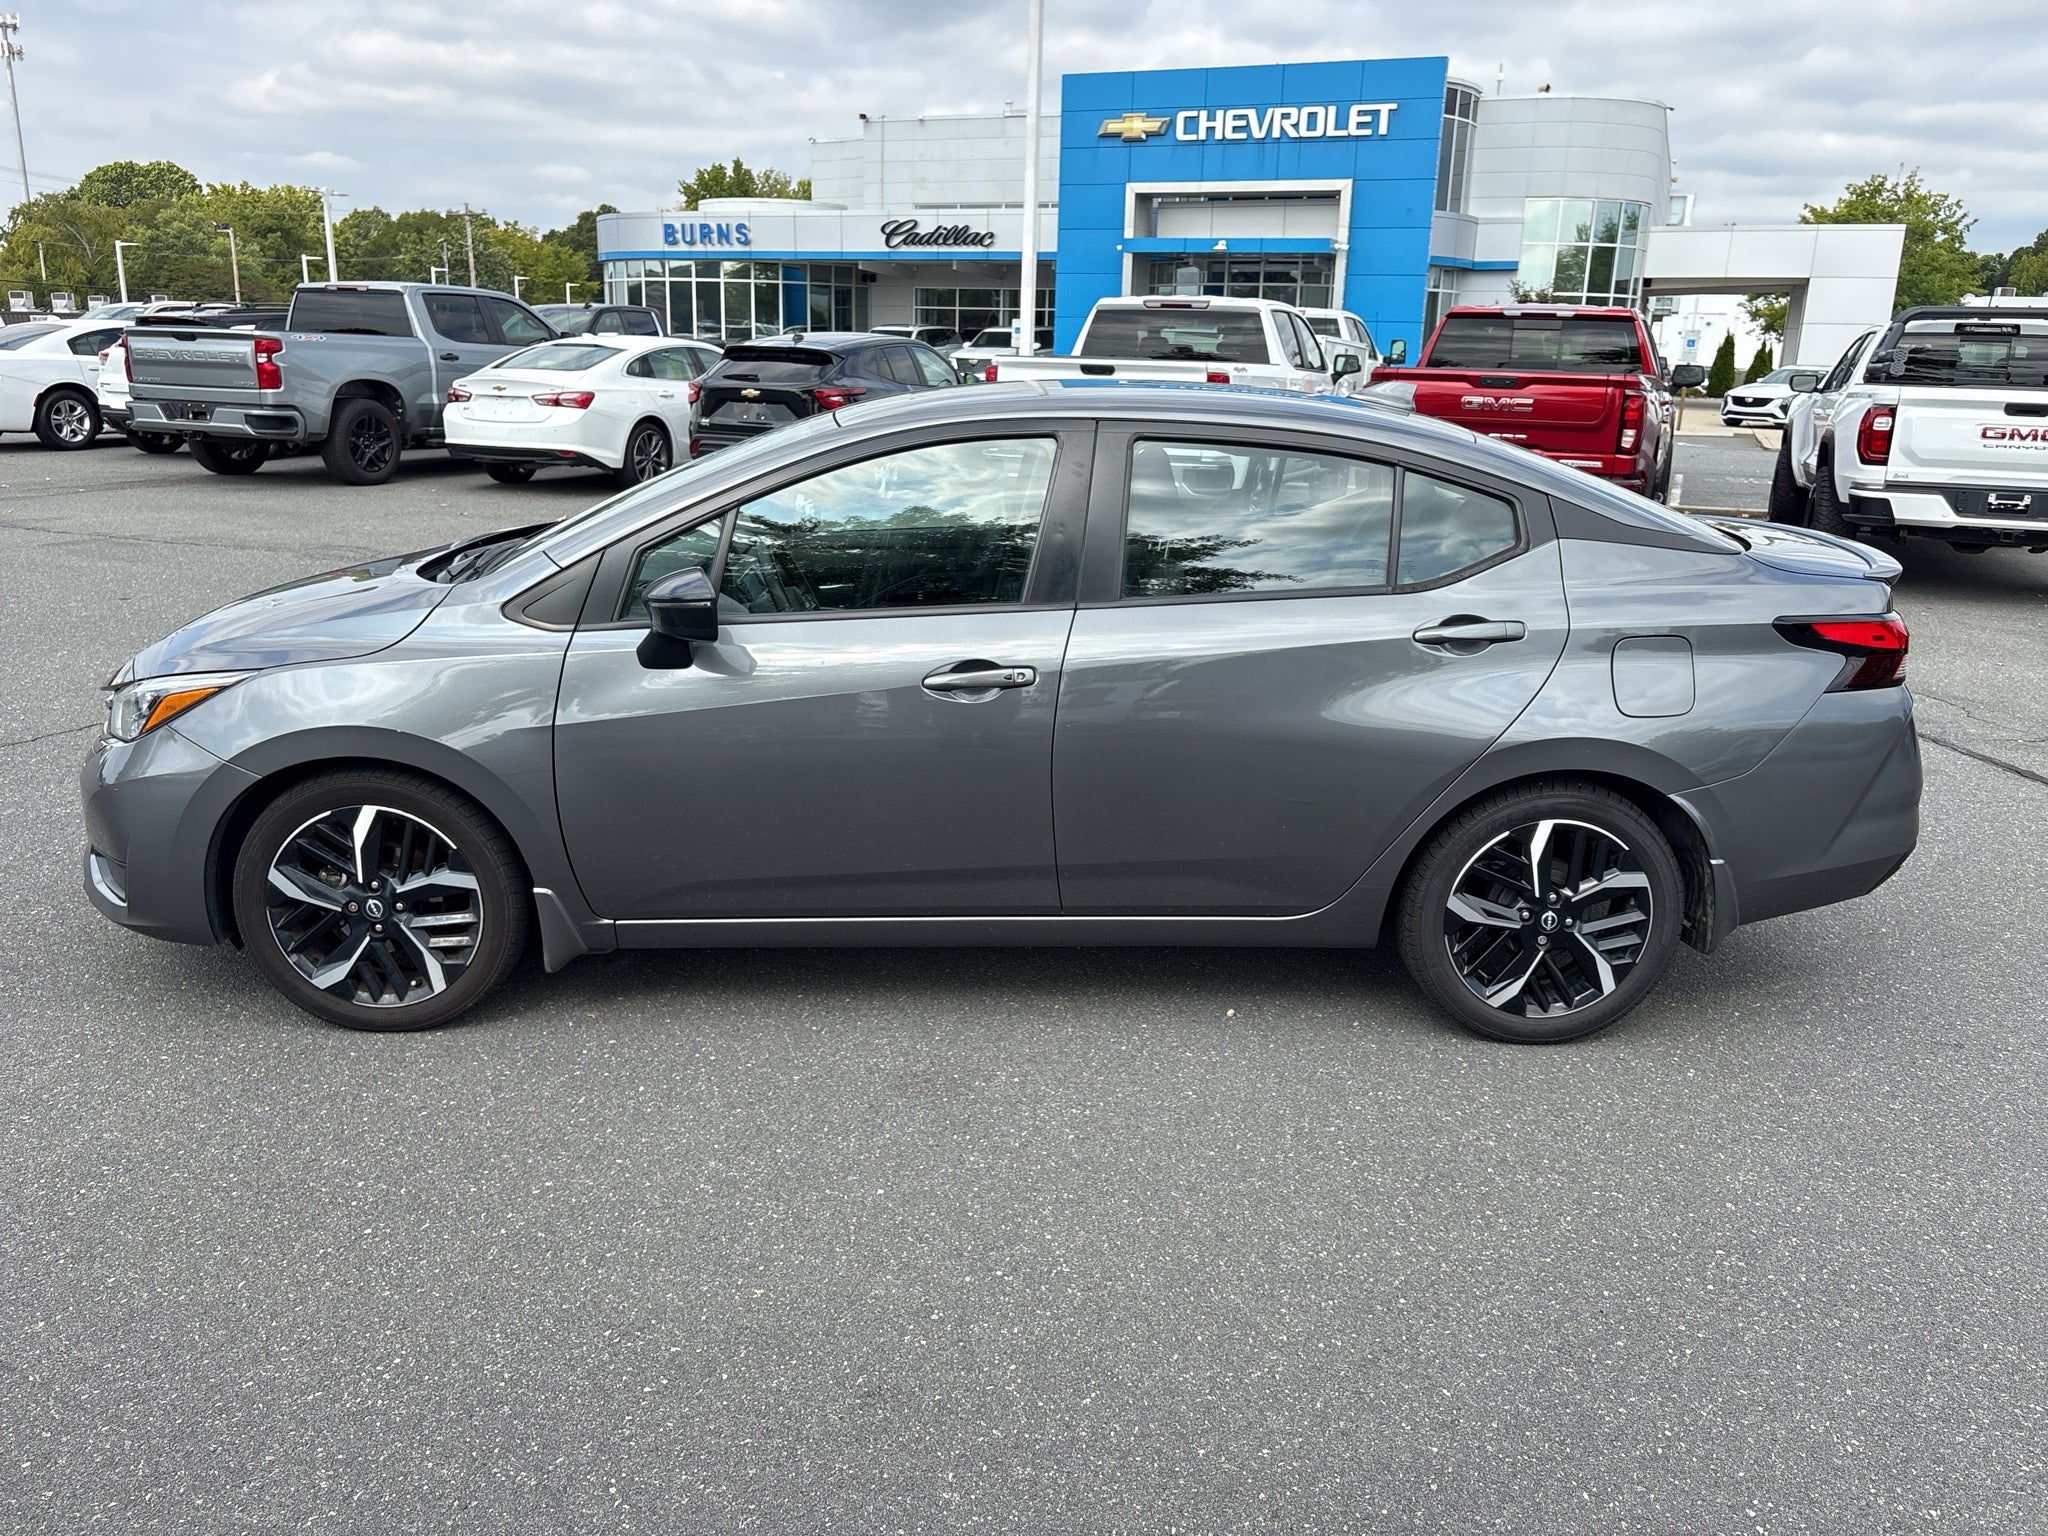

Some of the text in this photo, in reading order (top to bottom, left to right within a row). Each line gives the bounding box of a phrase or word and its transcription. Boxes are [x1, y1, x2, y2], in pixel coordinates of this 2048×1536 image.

[1175, 103, 1398, 141] CHEVROLET
[663, 223, 750, 246] BURNS
[880, 219, 995, 249] Cadillac
[133, 349, 246, 363] CHEVROLET
[1461, 395, 1534, 412] GMC
